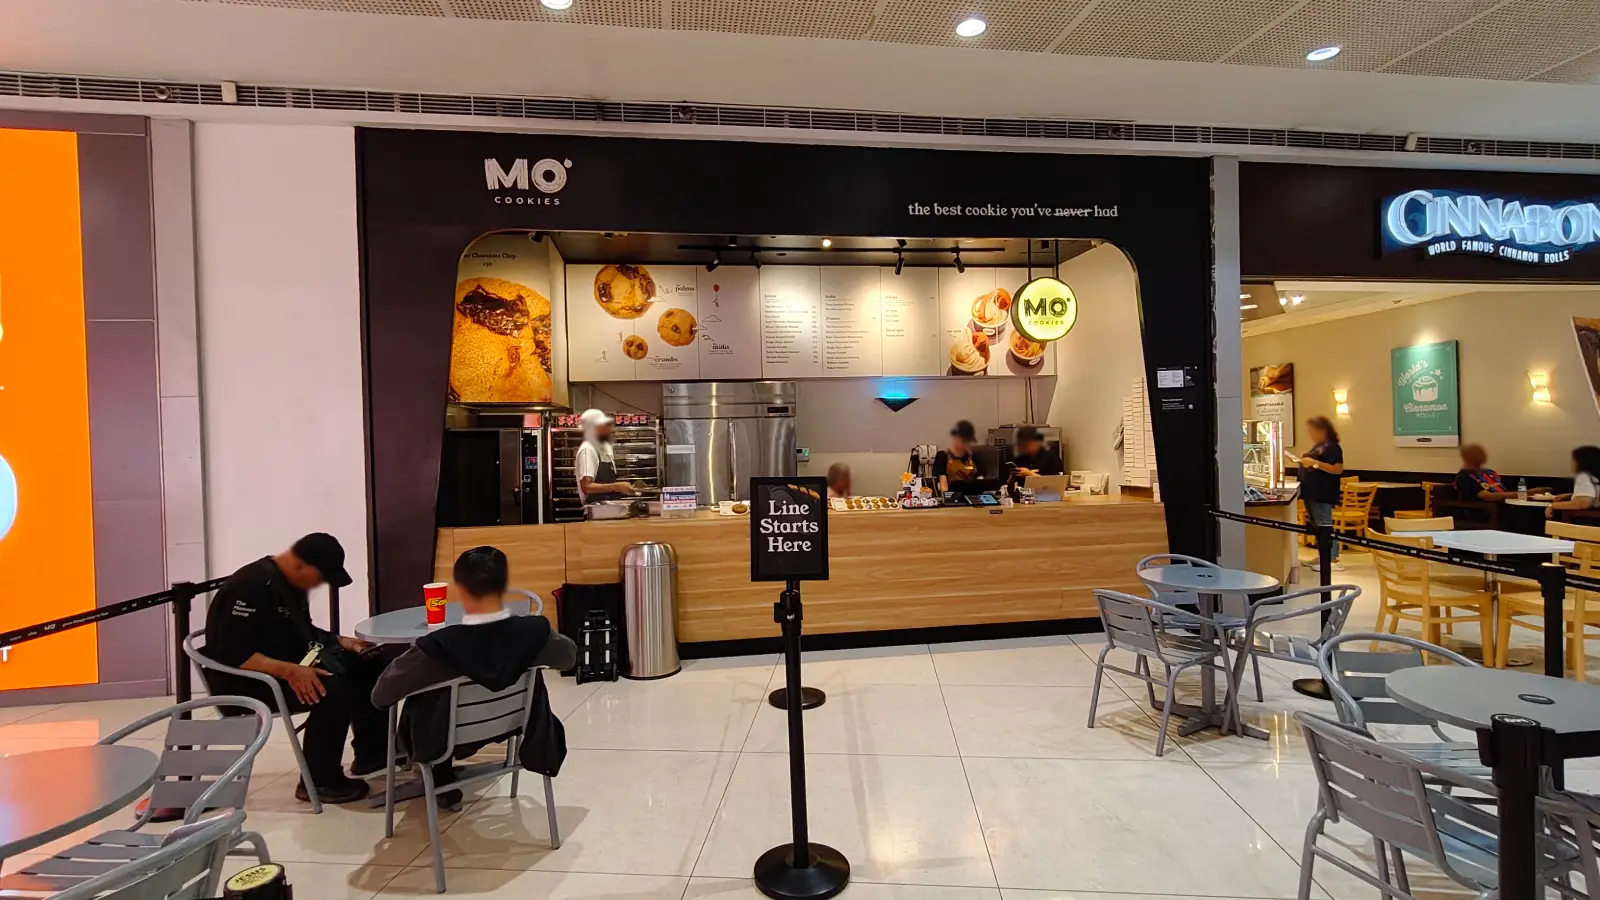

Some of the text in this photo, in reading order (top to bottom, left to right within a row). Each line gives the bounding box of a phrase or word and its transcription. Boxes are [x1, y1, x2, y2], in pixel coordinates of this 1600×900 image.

[494, 196, 560, 206] COOKIES
[908, 202, 1119, 219] the best cookie you've never had
[501, 253, 517, 261] Chip
[1428, 240, 1570, 264] WORLD FAMOUS CINNAMON ROLLS
[1398, 360, 1429, 387] World's
[1404, 402, 1449, 413] Cinnamon
[768, 499, 810, 516] Line
[759, 518, 819, 534] Starts
[767, 536, 812, 552] Here
